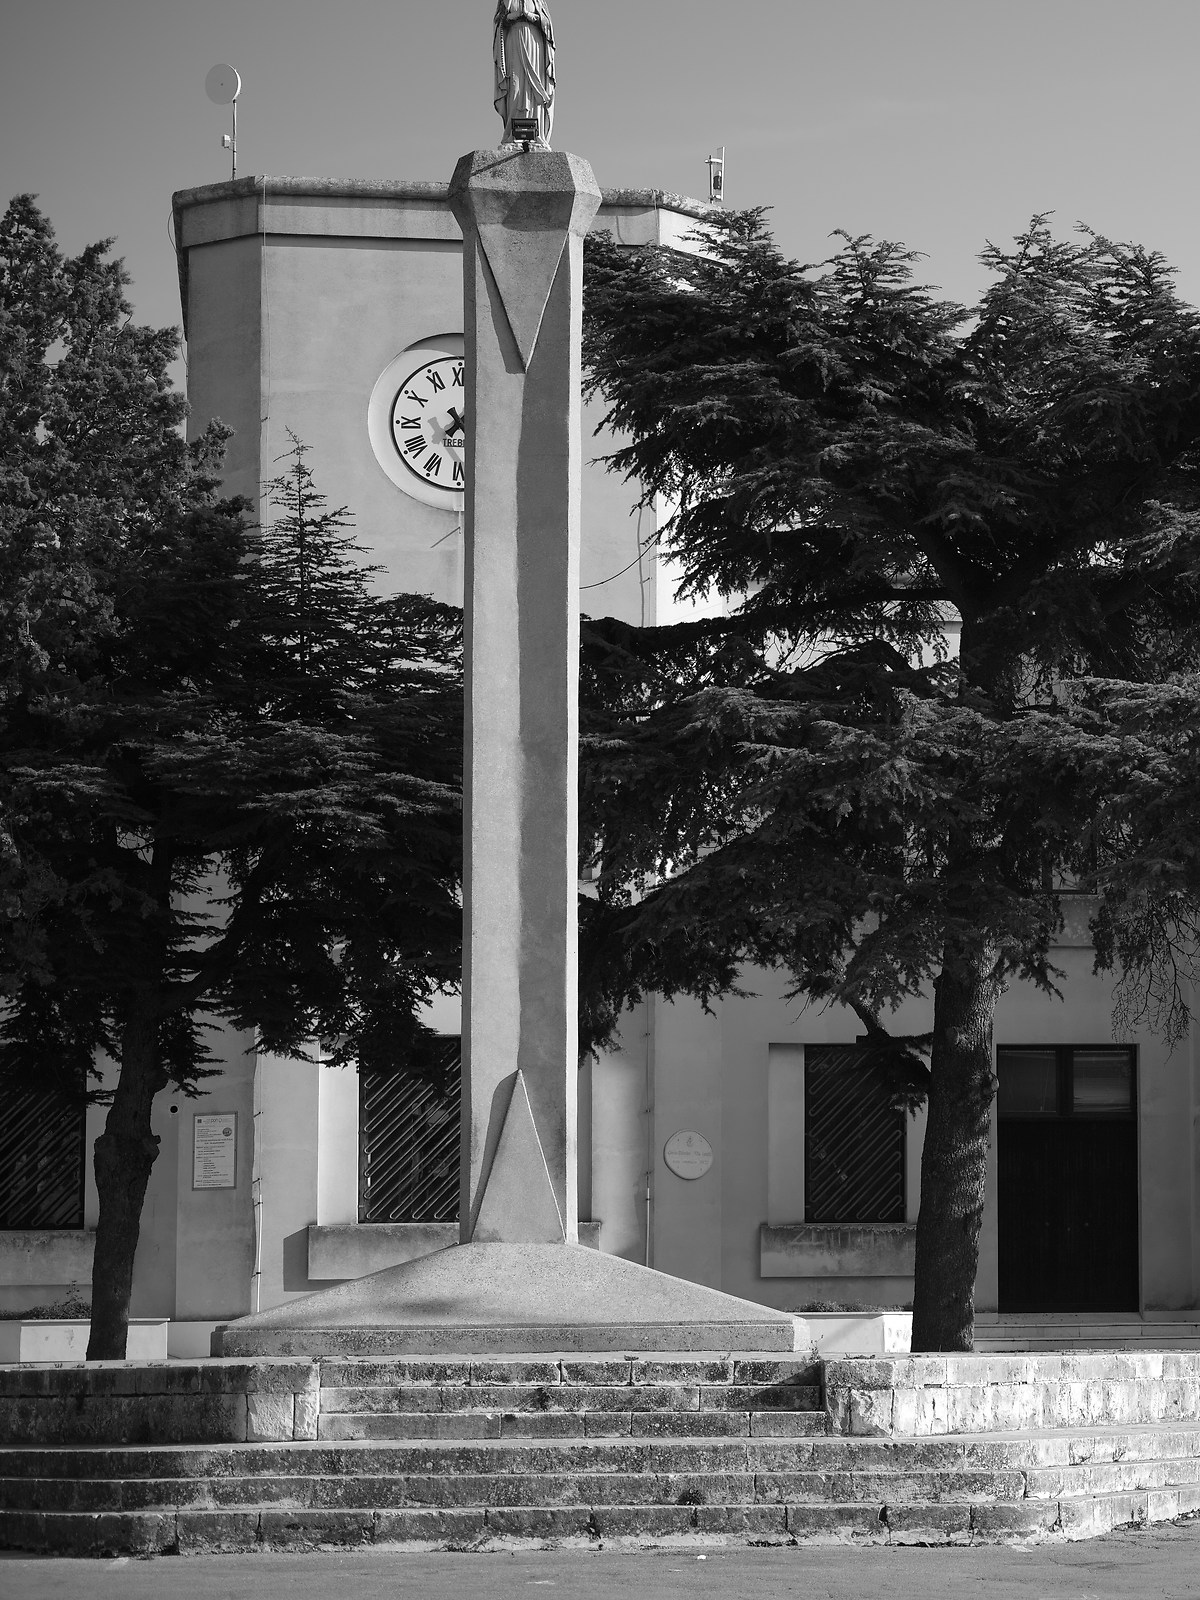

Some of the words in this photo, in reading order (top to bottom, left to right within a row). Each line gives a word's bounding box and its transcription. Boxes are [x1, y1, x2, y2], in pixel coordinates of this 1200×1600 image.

[426, 371, 446, 393] XI
[452, 367, 464, 386] XI
[407, 390, 428, 408] X
